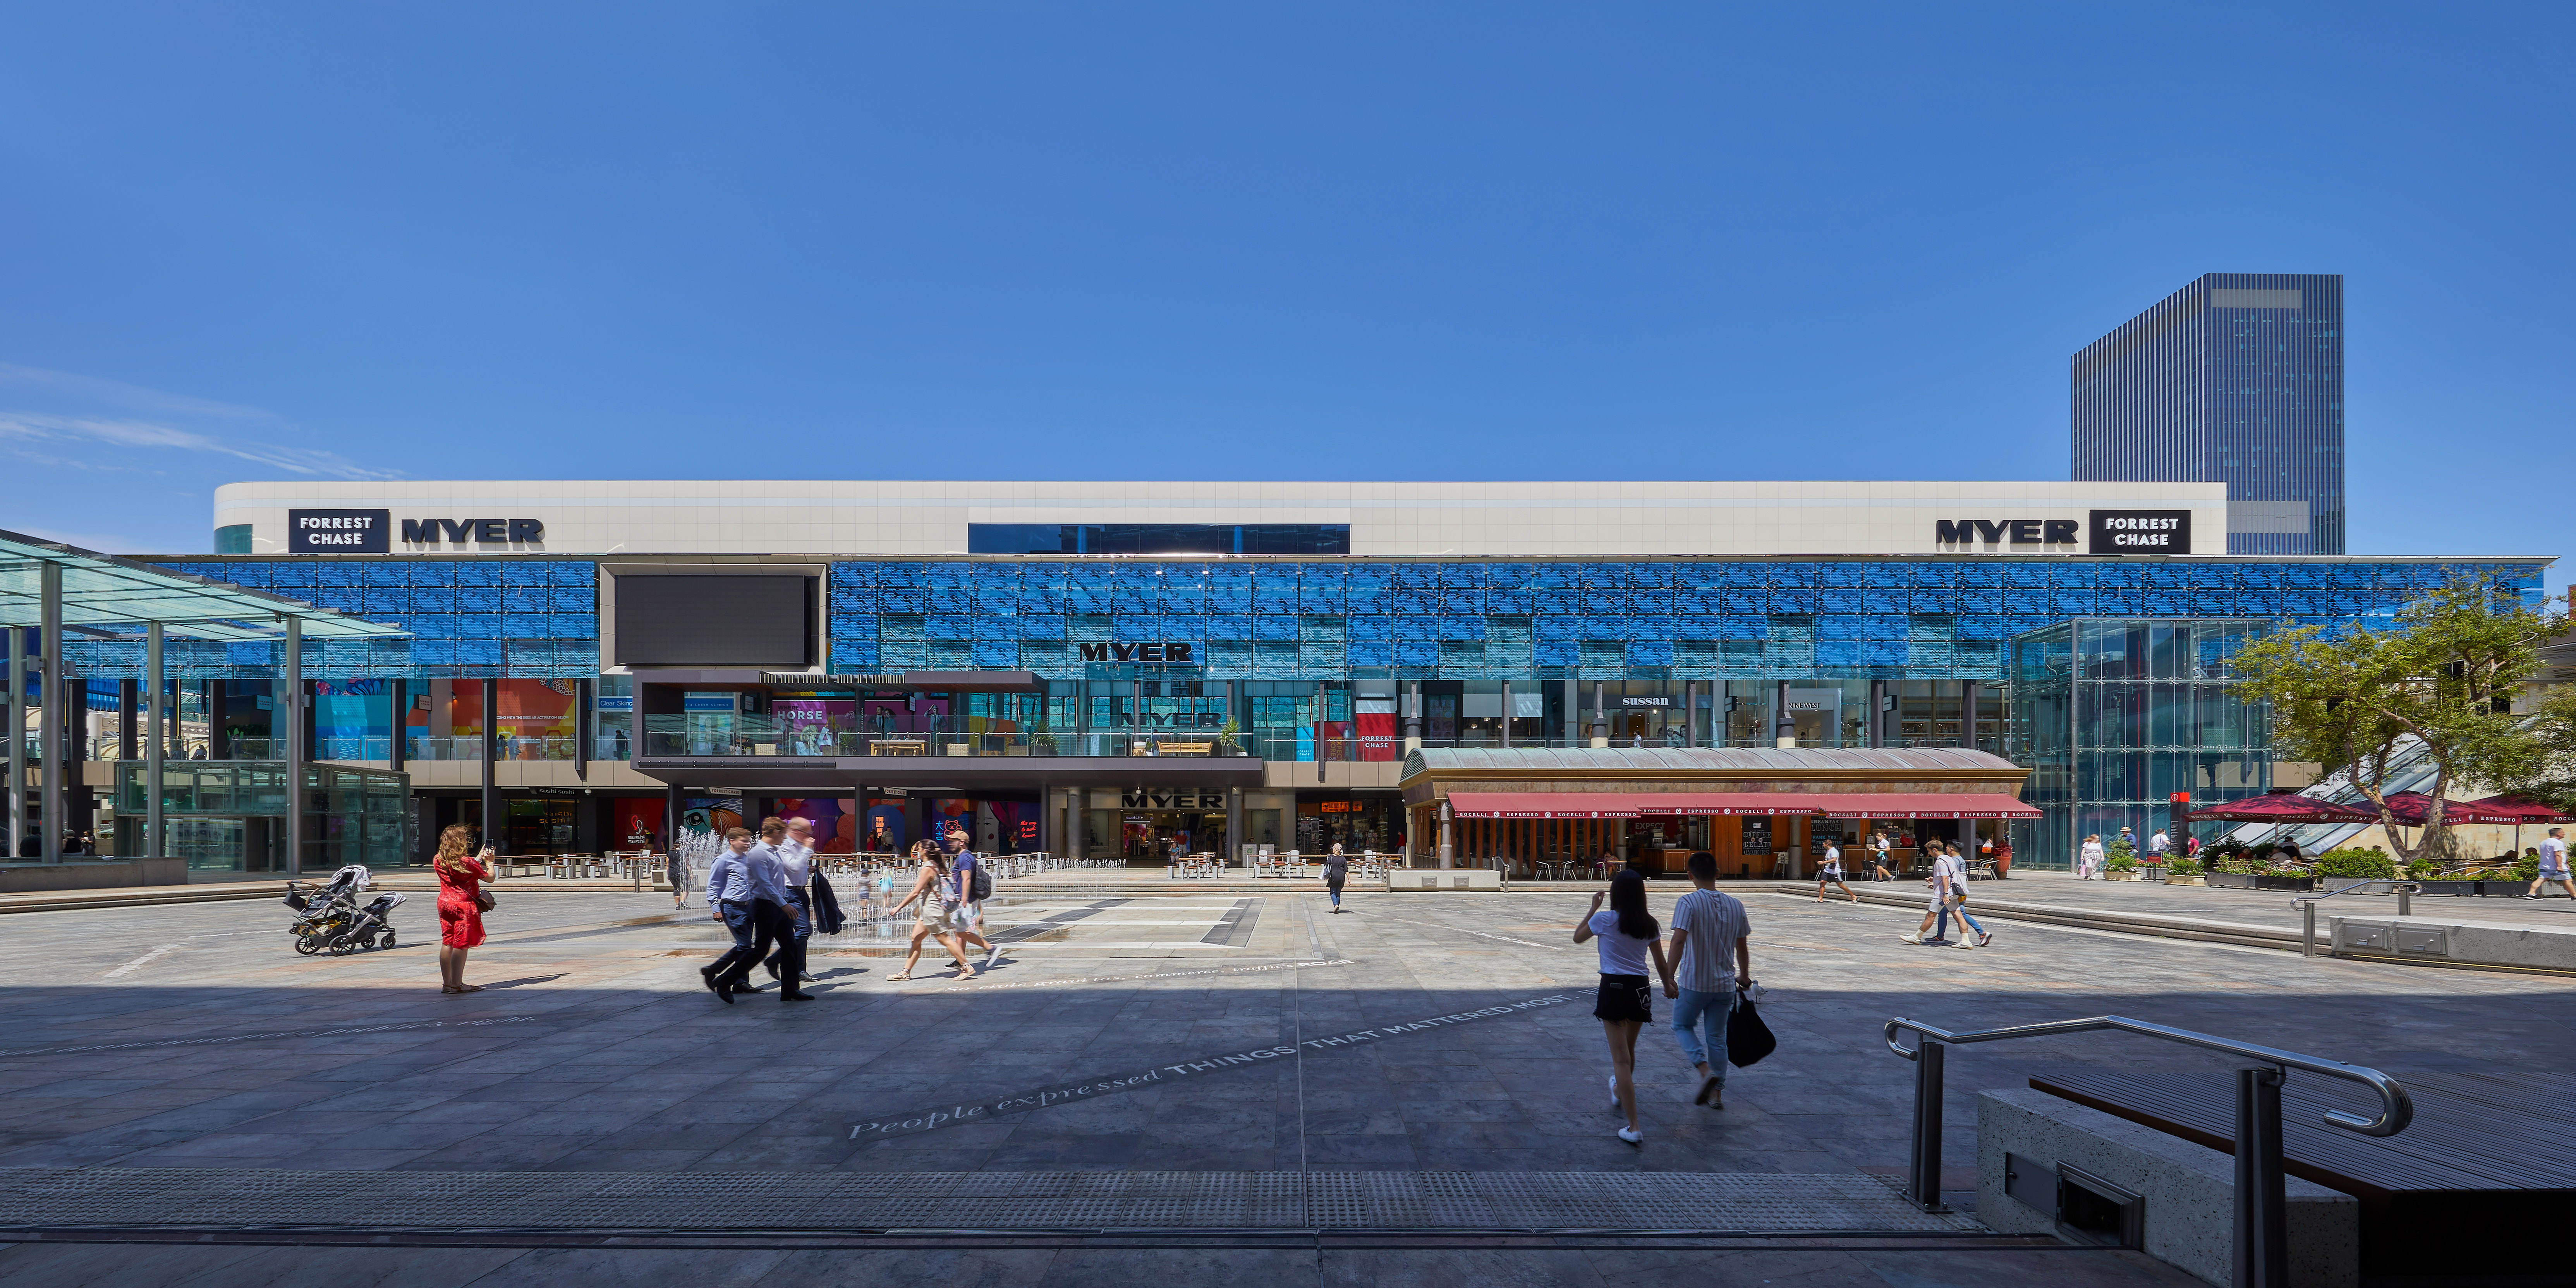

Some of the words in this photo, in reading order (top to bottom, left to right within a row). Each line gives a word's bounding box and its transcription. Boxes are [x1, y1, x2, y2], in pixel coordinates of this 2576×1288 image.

[300, 517, 372, 529] FORREST
[402, 519, 544, 543] MYER
[2106, 518, 2179, 529] FORREST
[309, 533, 363, 544] CHASE
[1936, 520, 2079, 544] MYER
[2115, 534, 2169, 546] CHASE
[1080, 643, 1192, 662] MYER
[777, 711, 823, 720] HORSE
[1122, 795, 1223, 808] MYER
[935, 820, 944, 841] 大吉
[979, 982, 1027, 990] civic
[1297, 959, 1355, 967] ROAR
[848, 1106, 983, 1139] People
[998, 1070, 1162, 1106] expressed
[1164, 1046, 1297, 1075] THINGS
[1301, 1030, 1381, 1049] THAT
[1381, 1006, 1514, 1034] MATTERED
